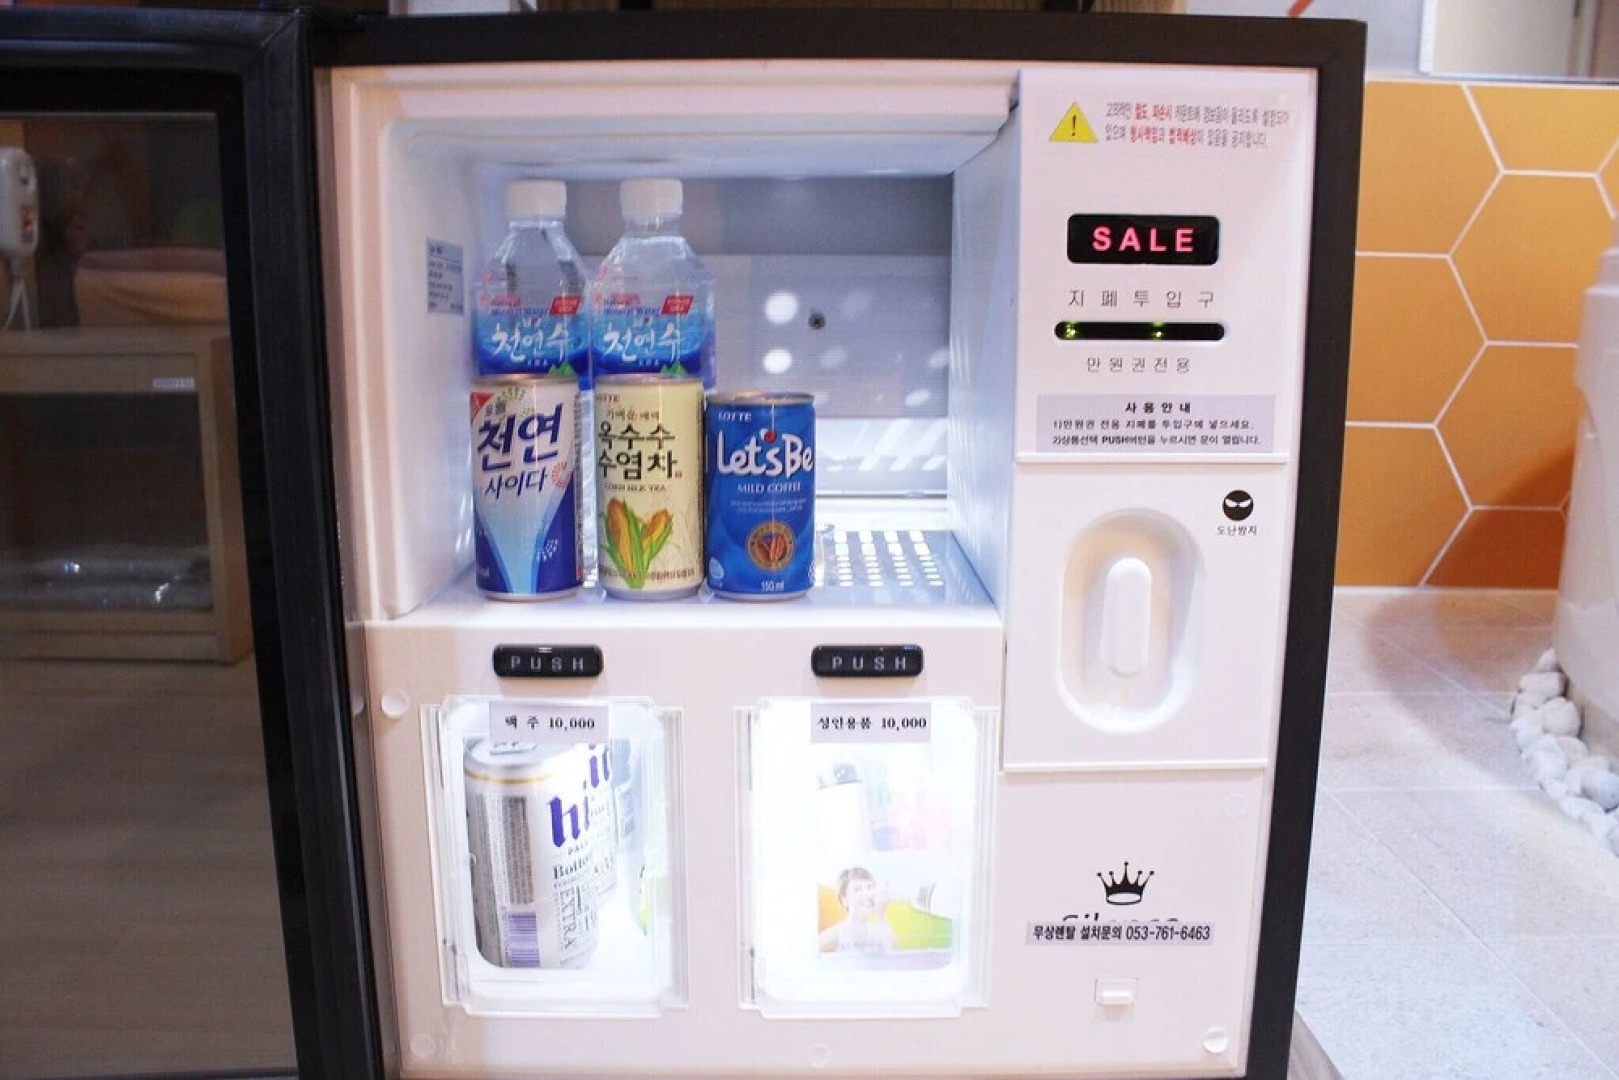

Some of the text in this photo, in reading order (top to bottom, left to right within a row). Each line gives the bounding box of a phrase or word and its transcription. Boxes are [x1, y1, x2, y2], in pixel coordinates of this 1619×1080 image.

[1092, 226, 1194, 252] SALE
[719, 412, 752, 421] LOTTE
[478, 404, 563, 471] 천연
[599, 421, 675, 451] 옥수수
[717, 428, 814, 479] Let's Be
[598, 450, 677, 480] 수염차
[485, 467, 547, 499] 사이다
[510, 655, 584, 672] PUSH
[831, 655, 907, 671] PUSH
[549, 717, 596, 731] 10,000
[881, 717, 928, 731] 10,000
[1126, 925, 1210, 940] 053-761-6463
